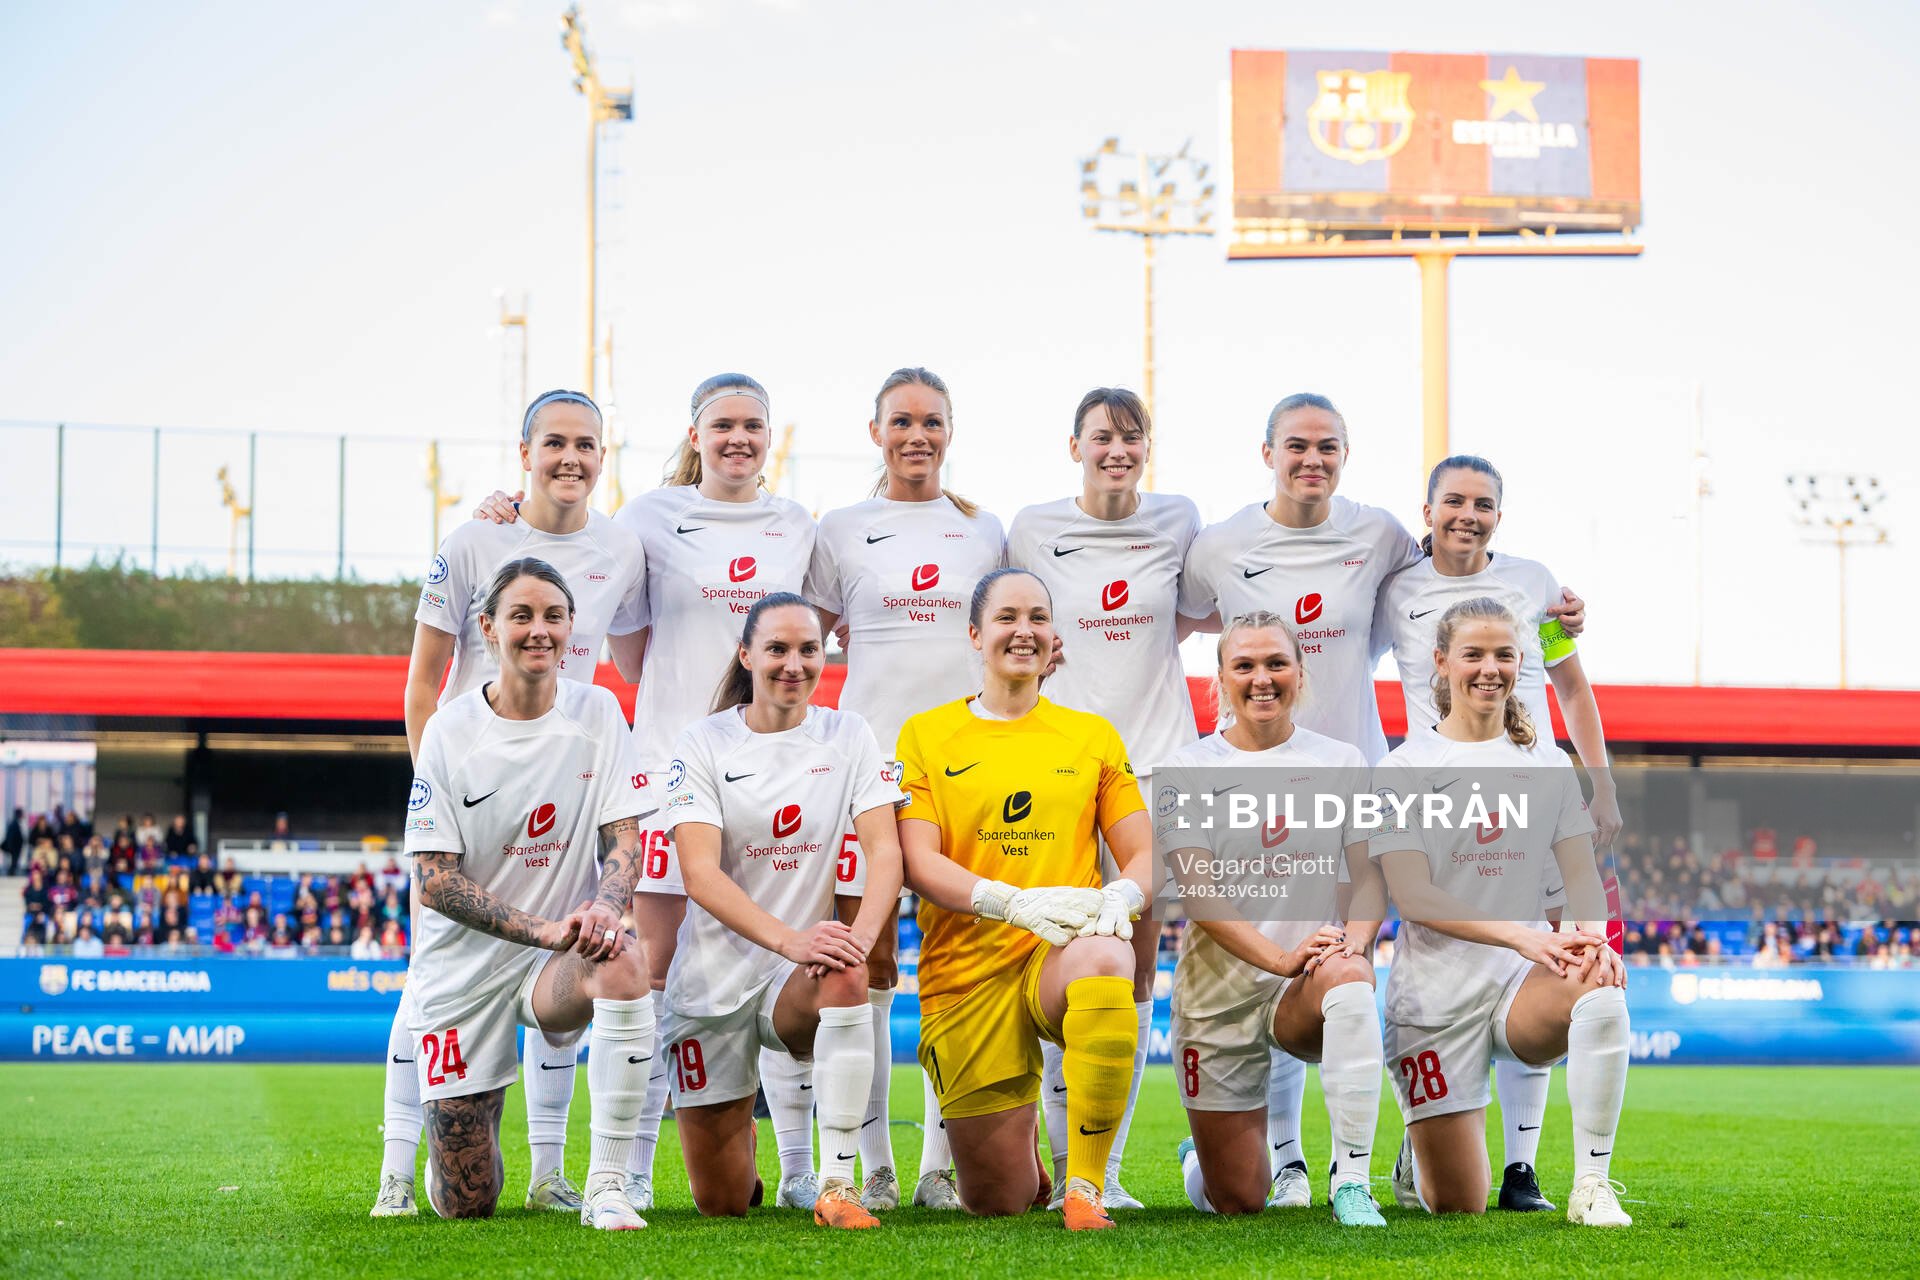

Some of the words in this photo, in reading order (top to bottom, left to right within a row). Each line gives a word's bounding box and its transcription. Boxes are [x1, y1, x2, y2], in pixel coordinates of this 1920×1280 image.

[701, 587, 772, 601] Sparebank
[728, 602, 751, 614] Ves
[883, 596, 962, 610] Sparebanken
[908, 610, 936, 622] Vest
[1078, 614, 1154, 631] Sparebanken
[1104, 630, 1131, 641] Vest
[1296, 627, 1346, 640] ebanken
[977, 828, 1056, 843] Sparebanken
[639, 829, 670, 880] 16
[1001, 844, 1029, 856] Vest
[1451, 849, 1526, 865] Sparebanken
[525, 857, 549, 868] Vest
[772, 859, 799, 871] Vest
[1477, 865, 1504, 877] Vest
[71, 969, 97, 991] FC
[97, 970, 212, 992] BARCELONA
[32, 1024, 135, 1055] PEACE
[422, 1028, 468, 1087] 24
[670, 1038, 708, 1093] 19
[1183, 1047, 1200, 1098] 8
[1400, 1050, 1448, 1107] 28
